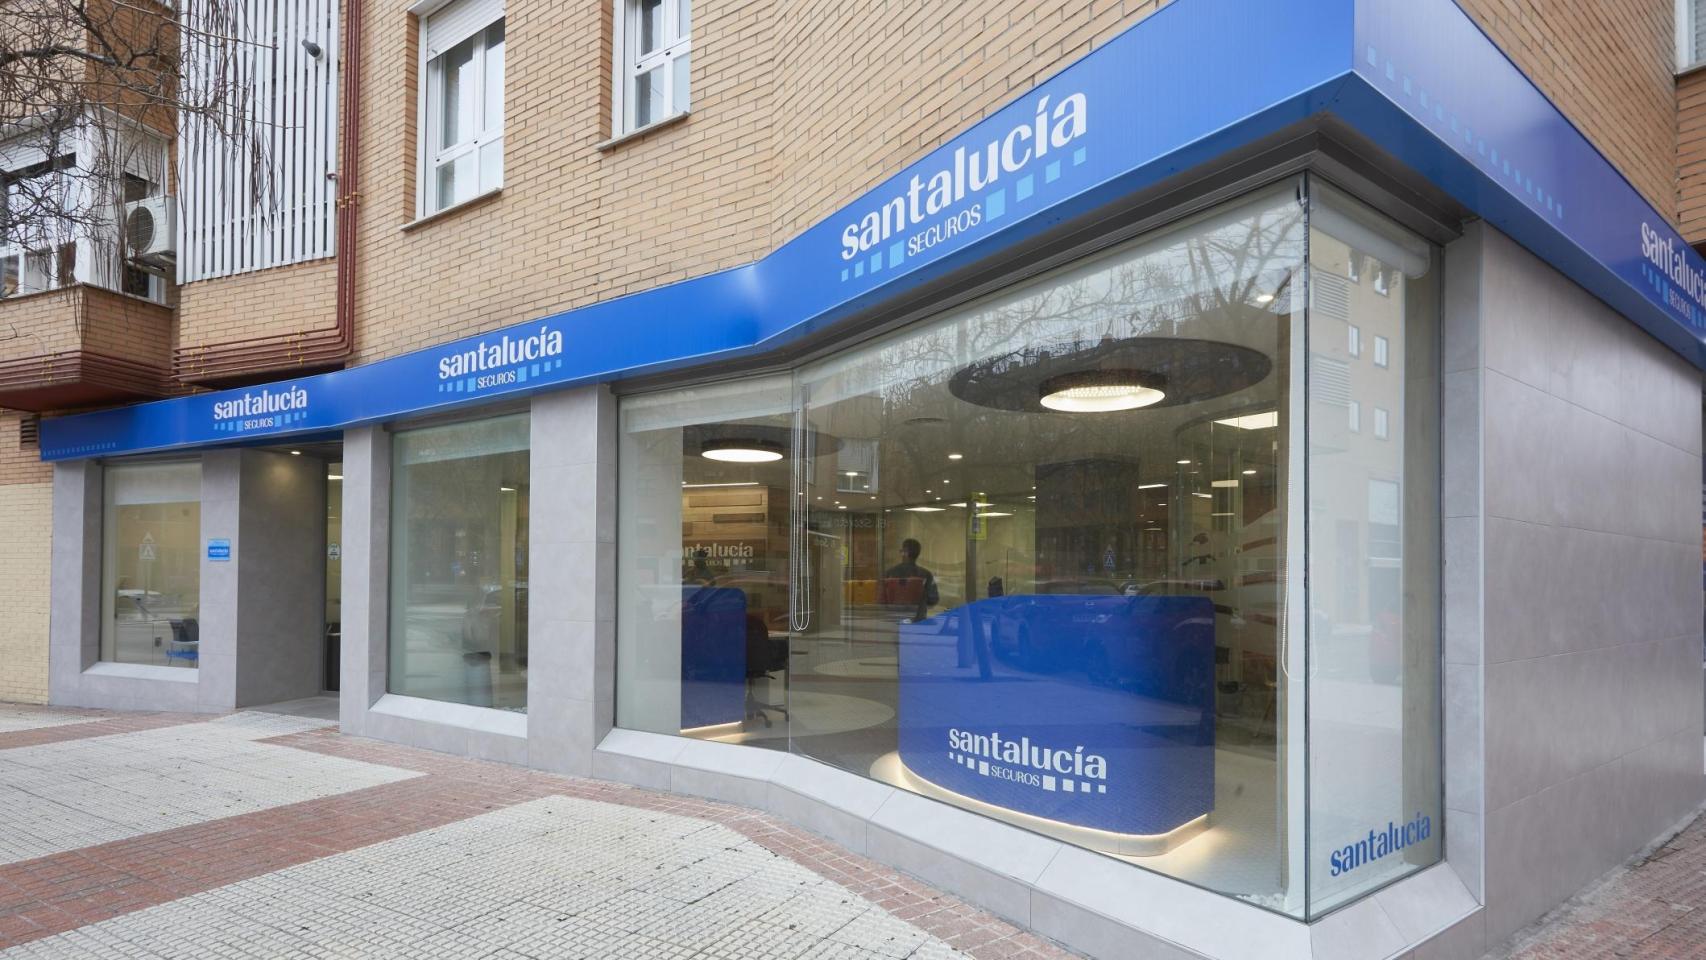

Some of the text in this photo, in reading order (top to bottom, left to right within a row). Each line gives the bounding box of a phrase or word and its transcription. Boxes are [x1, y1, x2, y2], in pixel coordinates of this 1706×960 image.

[841, 92, 1087, 260] santalucía
[907, 204, 982, 257] SEGUROS
[439, 326, 562, 379] santalucía
[477, 371, 516, 389] SEGUROS
[214, 385, 307, 420] santalucía
[244, 417, 274, 430] SEGUROS
[949, 728, 1106, 780] santalucía
[991, 766, 1040, 787] SEGUROS
